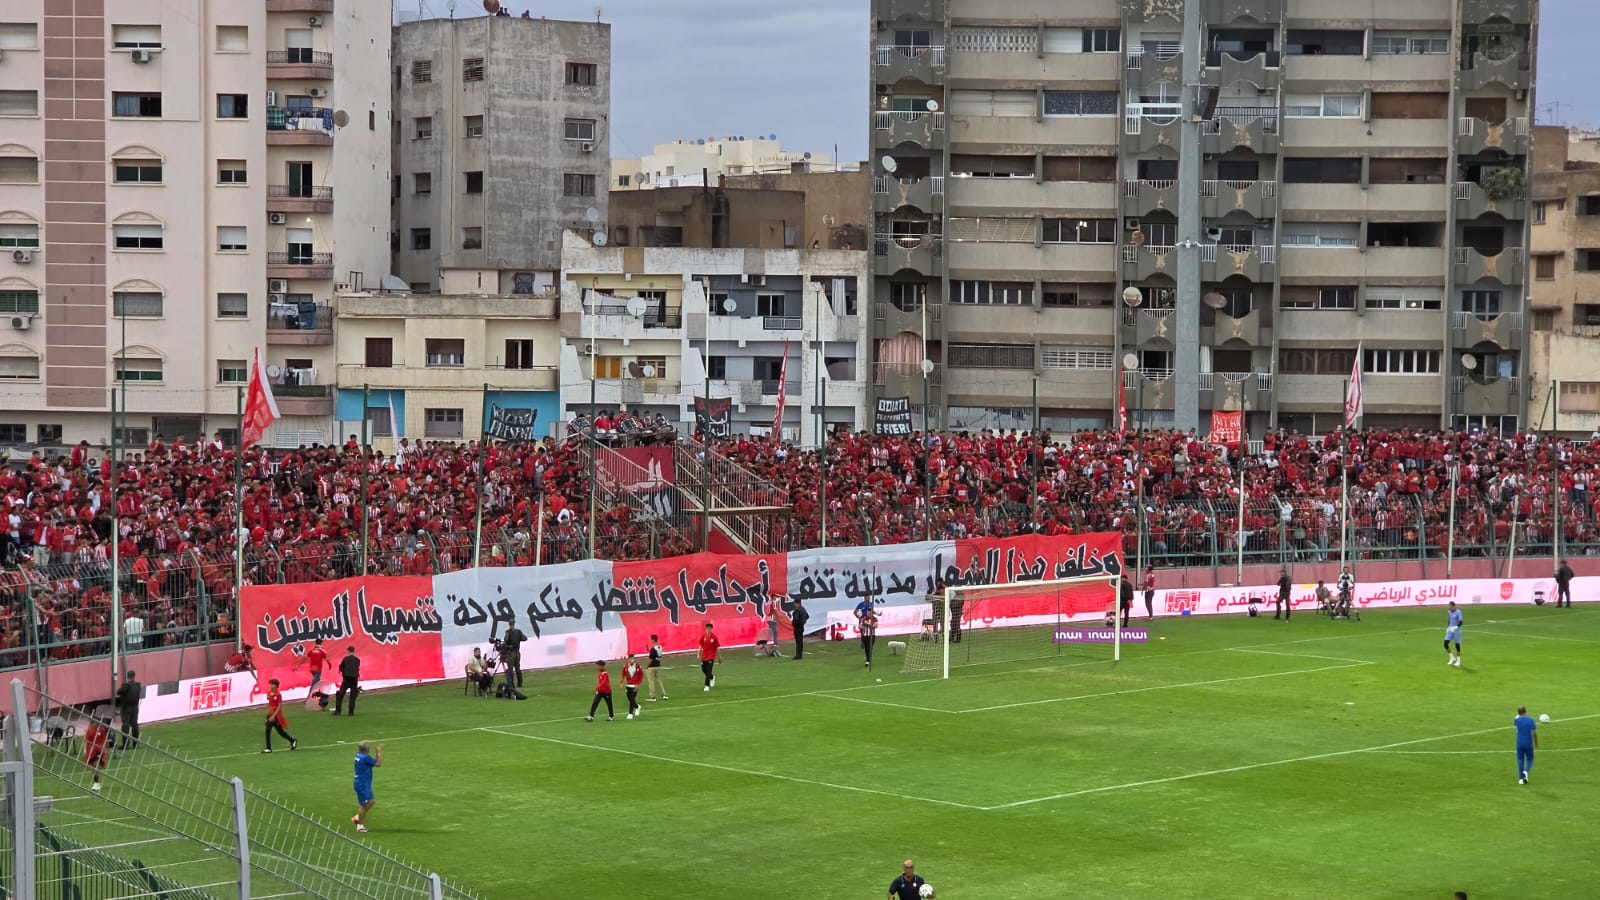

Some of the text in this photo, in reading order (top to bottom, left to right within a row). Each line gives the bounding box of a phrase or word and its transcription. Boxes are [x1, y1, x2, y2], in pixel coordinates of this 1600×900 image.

[883, 423, 911, 434] FIERI
[844, 568, 916, 604] مدينة
[1006, 547, 1048, 583] هذا
[1053, 543, 1121, 588] وخلف
[447, 584, 515, 638] فرحة
[527, 577, 583, 639] منكم
[592, 576, 680, 632] وتنتظر
[679, 559, 770, 621] أوجاعها
[1359, 586, 1411, 608] الرياضي
[1415, 585, 1457, 604] النادي
[257, 589, 353, 656] السنين
[357, 585, 443, 645] تنسيها
